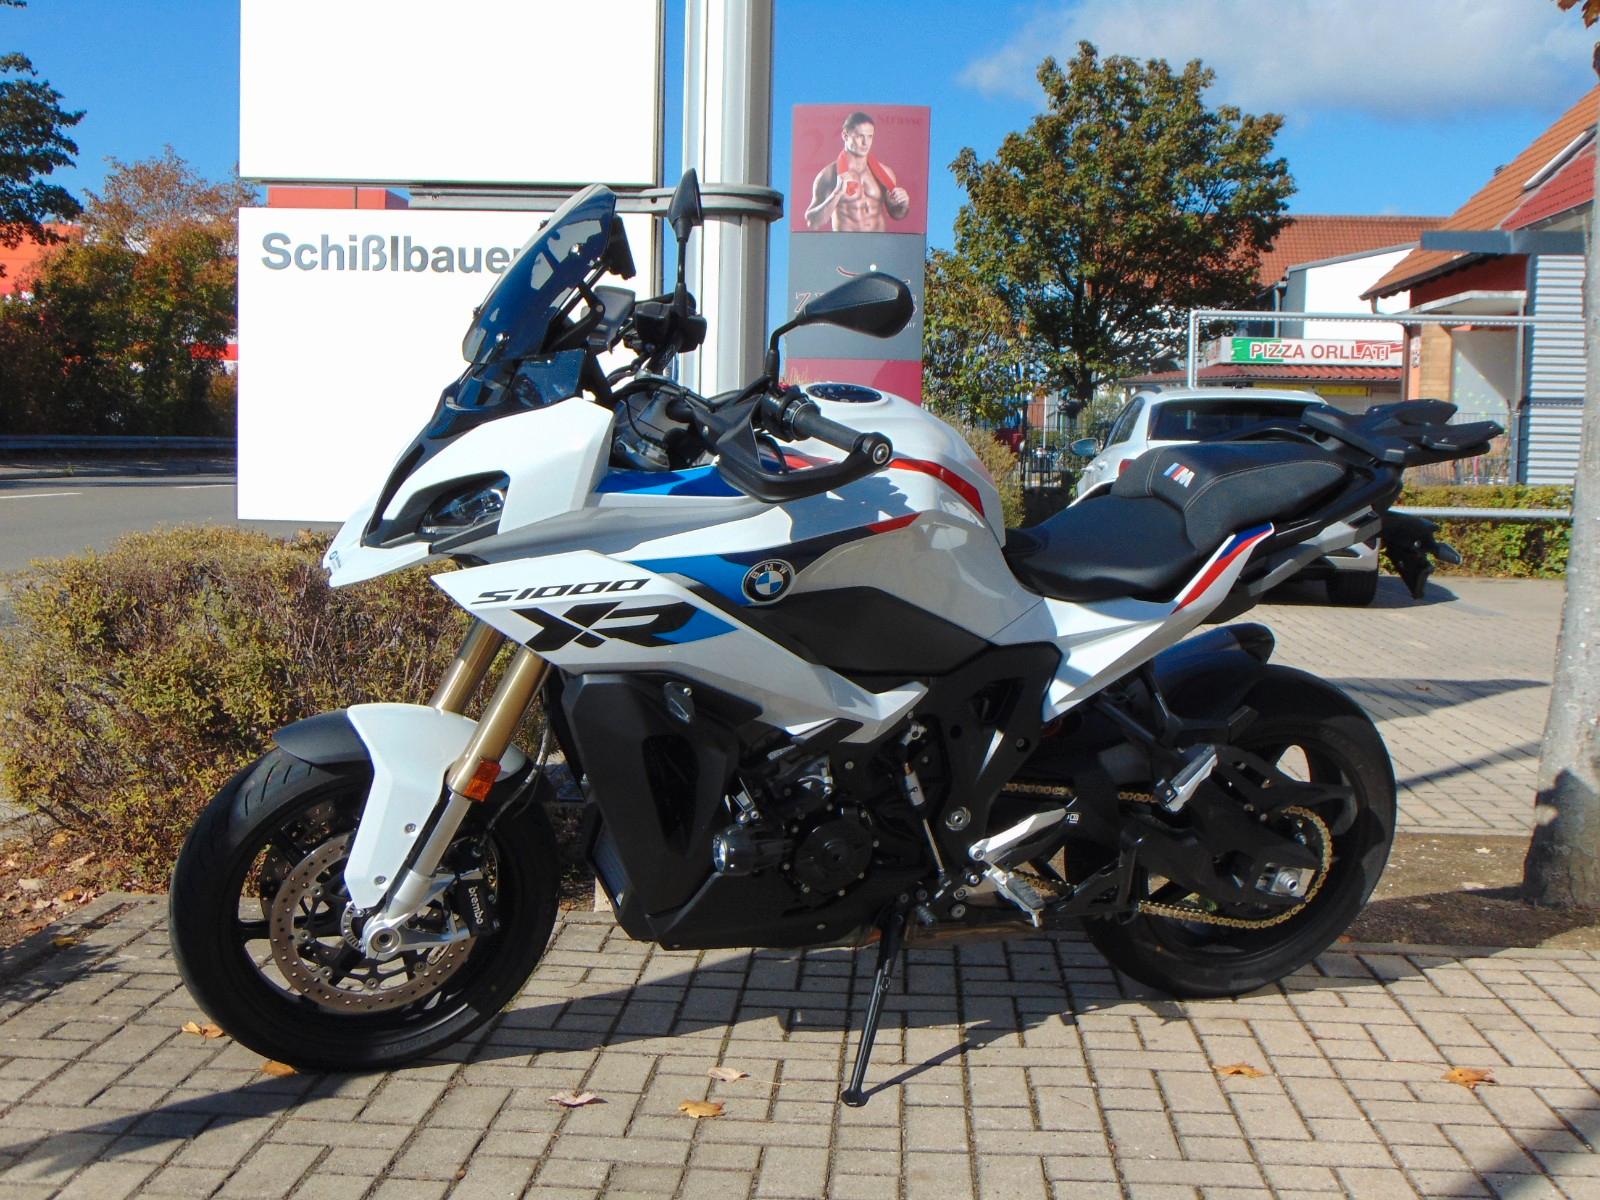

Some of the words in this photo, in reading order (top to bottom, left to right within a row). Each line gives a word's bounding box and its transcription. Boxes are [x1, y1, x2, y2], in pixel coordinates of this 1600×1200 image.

[1251, 343, 1305, 359] PIZZA
[1311, 344, 1391, 361] ORLLATI
[750, 563, 788, 579] BMW
[510, 601, 700, 651] XR
[468, 886, 484, 925] brembo
